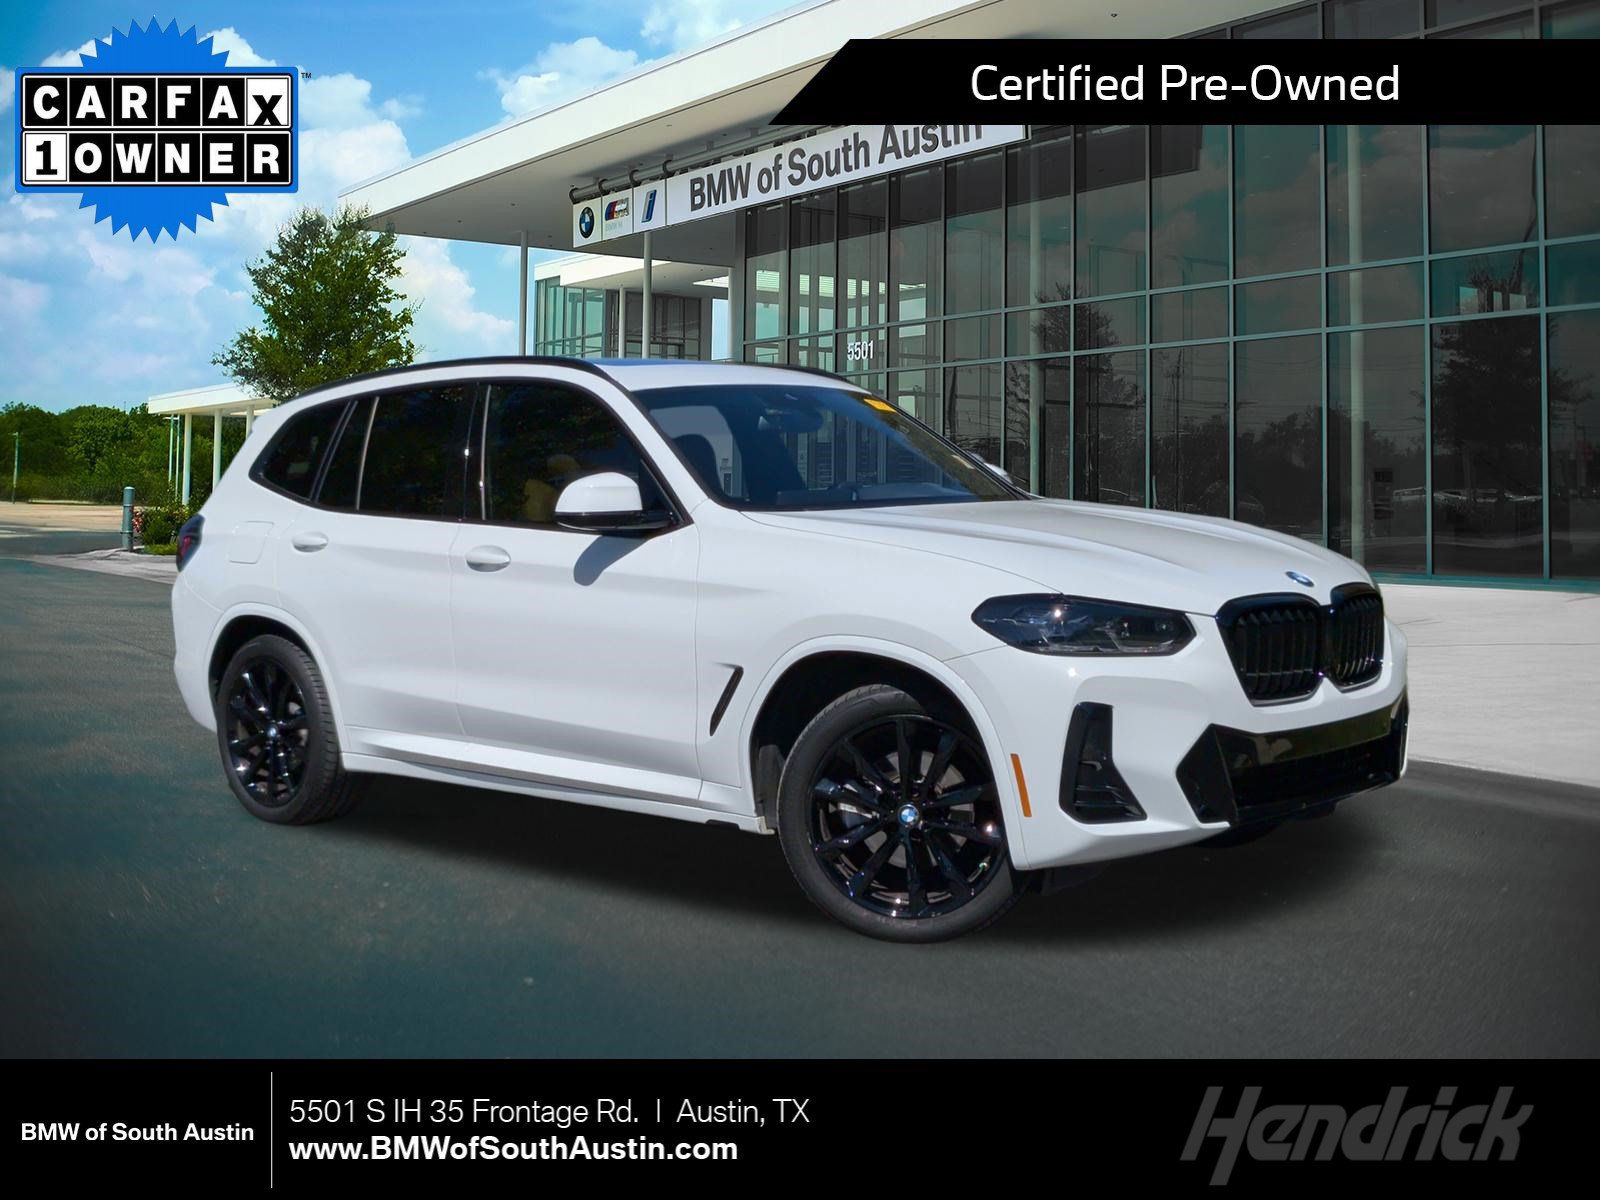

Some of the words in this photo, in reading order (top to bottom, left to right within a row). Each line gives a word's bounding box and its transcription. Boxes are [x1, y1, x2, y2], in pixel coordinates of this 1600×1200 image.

[689, 161, 752, 212] BMW
[757, 153, 783, 194] of
[787, 131, 871, 187] South
[847, 340, 874, 361] 5501
